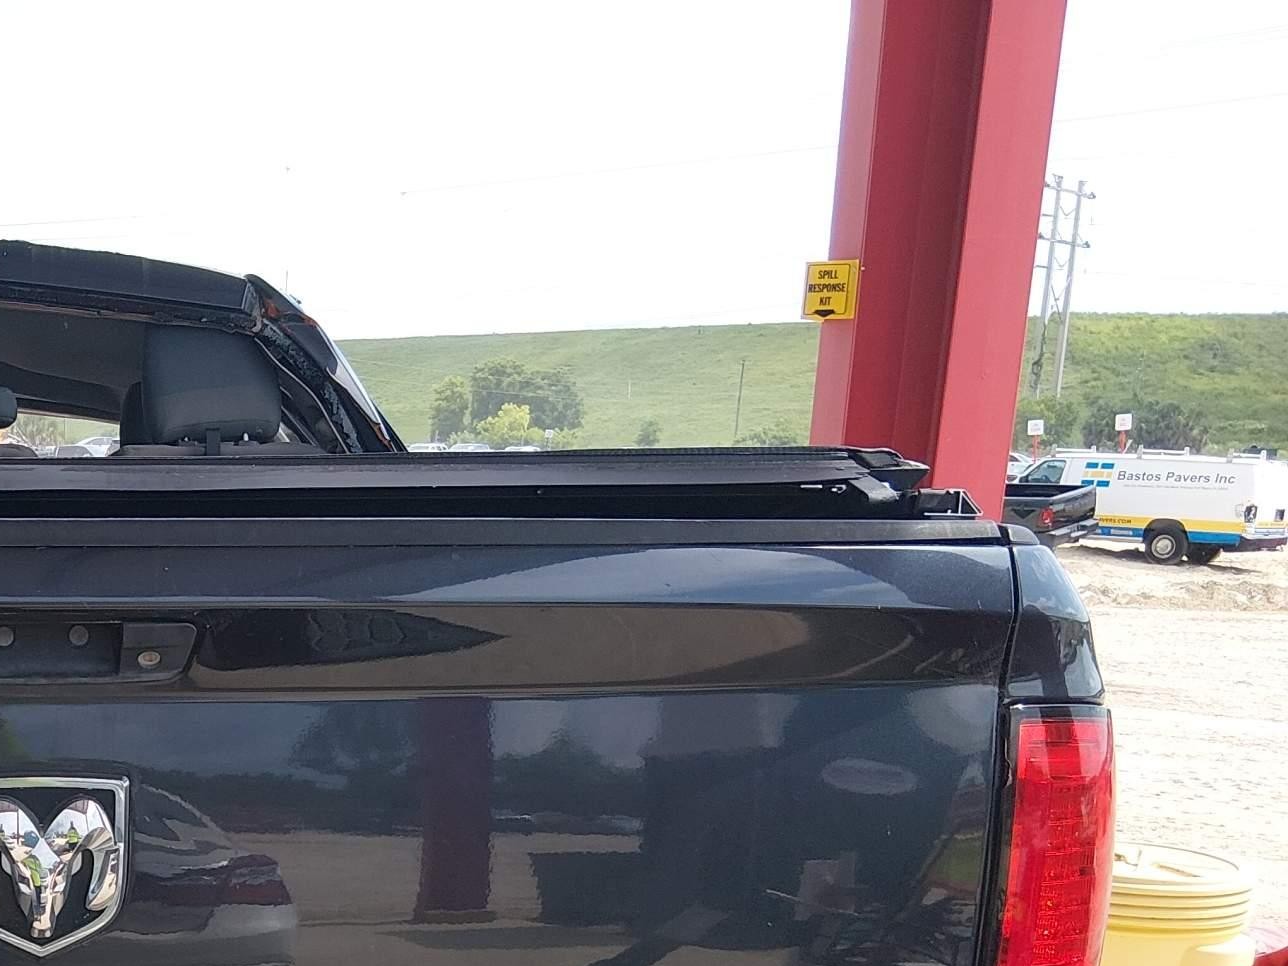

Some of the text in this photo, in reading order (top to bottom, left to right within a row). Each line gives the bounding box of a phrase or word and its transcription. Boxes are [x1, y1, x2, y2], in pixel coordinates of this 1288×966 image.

[817, 269, 839, 280] SPILL
[807, 282, 847, 293] RESPONSE
[818, 296, 833, 306] KIT
[1117, 470, 1236, 485] Bastos Pavers Inc
